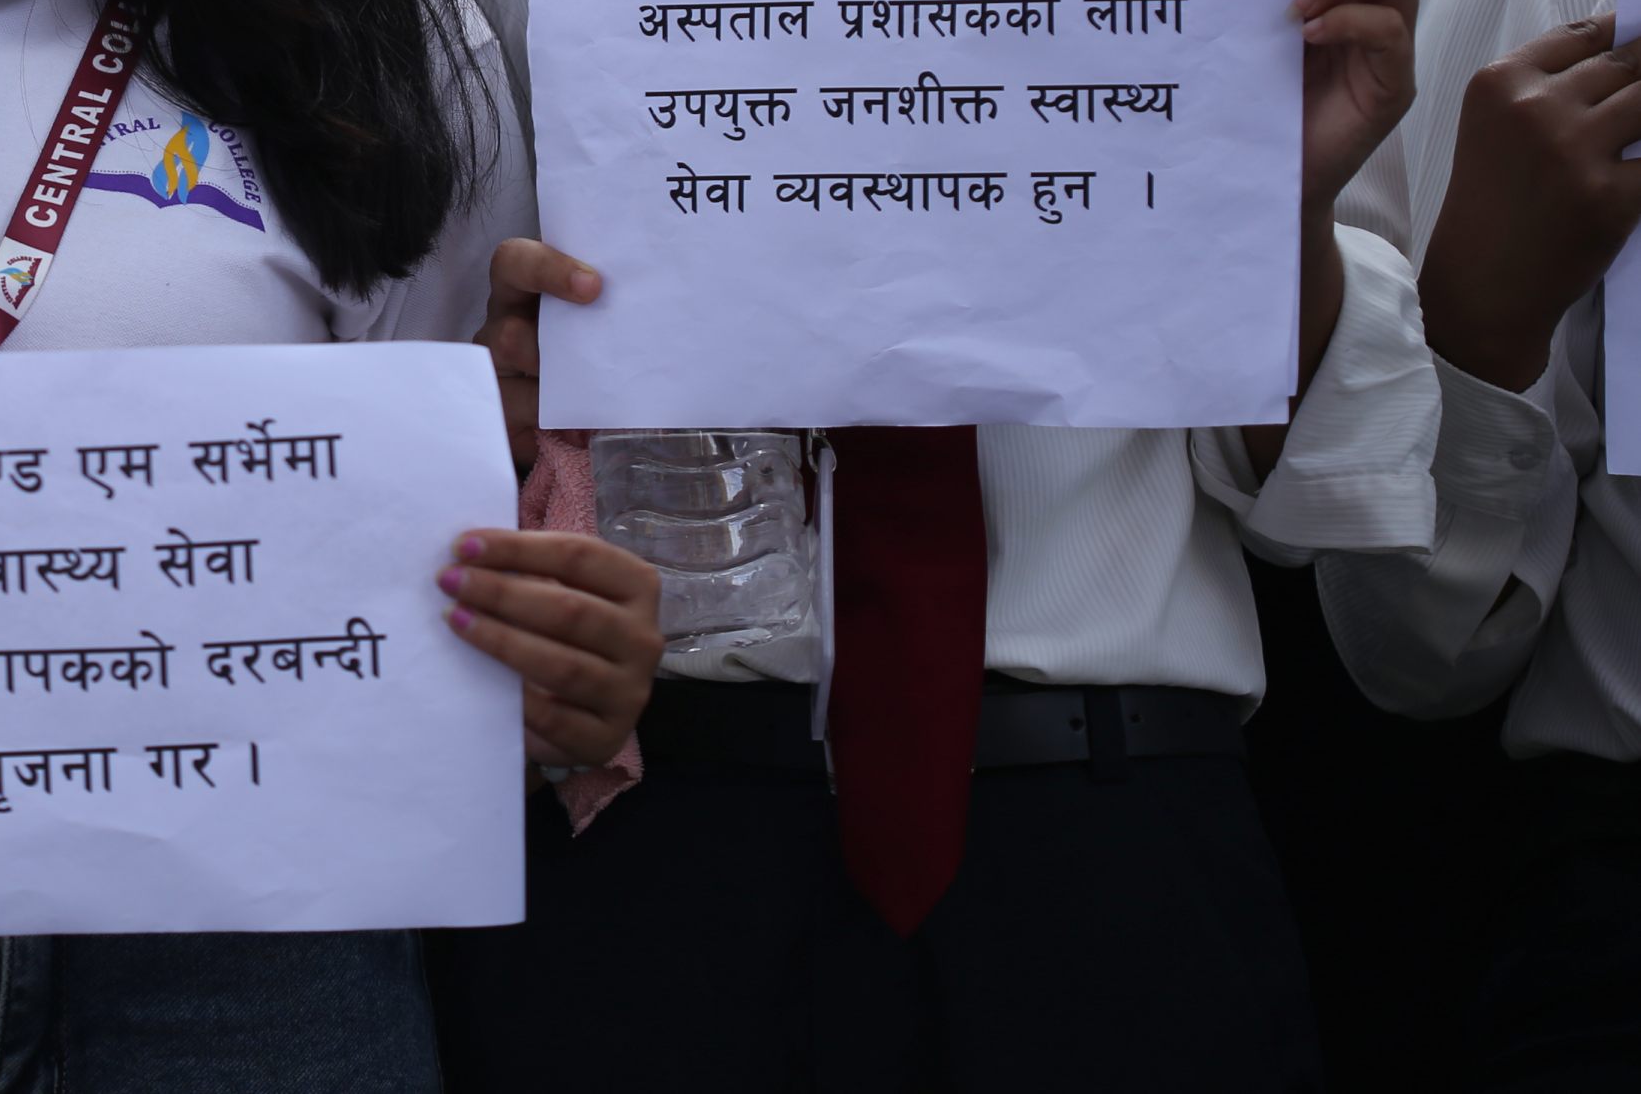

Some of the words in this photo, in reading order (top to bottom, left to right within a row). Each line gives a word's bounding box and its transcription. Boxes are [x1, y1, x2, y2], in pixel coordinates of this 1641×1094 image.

[638, 0, 815, 43] अस्पताल
[644, 87, 798, 142] उपयुक्त
[819, 70, 1005, 126] जनशीक्त
[1026, 83, 1180, 124] स्वास्थ्य
[25, 87, 112, 229] CENTRAL
[100, 116, 161, 146] TRAL
[209, 120, 262, 204] COLLEGE
[665, 161, 752, 215] सेवा
[772, 172, 1008, 212] व्यवस्थापक
[1030, 171, 1097, 225] हुन
[75, 443, 160, 500] एम
[187, 418, 343, 485] सर्भेमा
[153, 527, 260, 588] सेवा
[201, 616, 387, 686] दरबन्दी
[143, 742, 220, 789] गर
